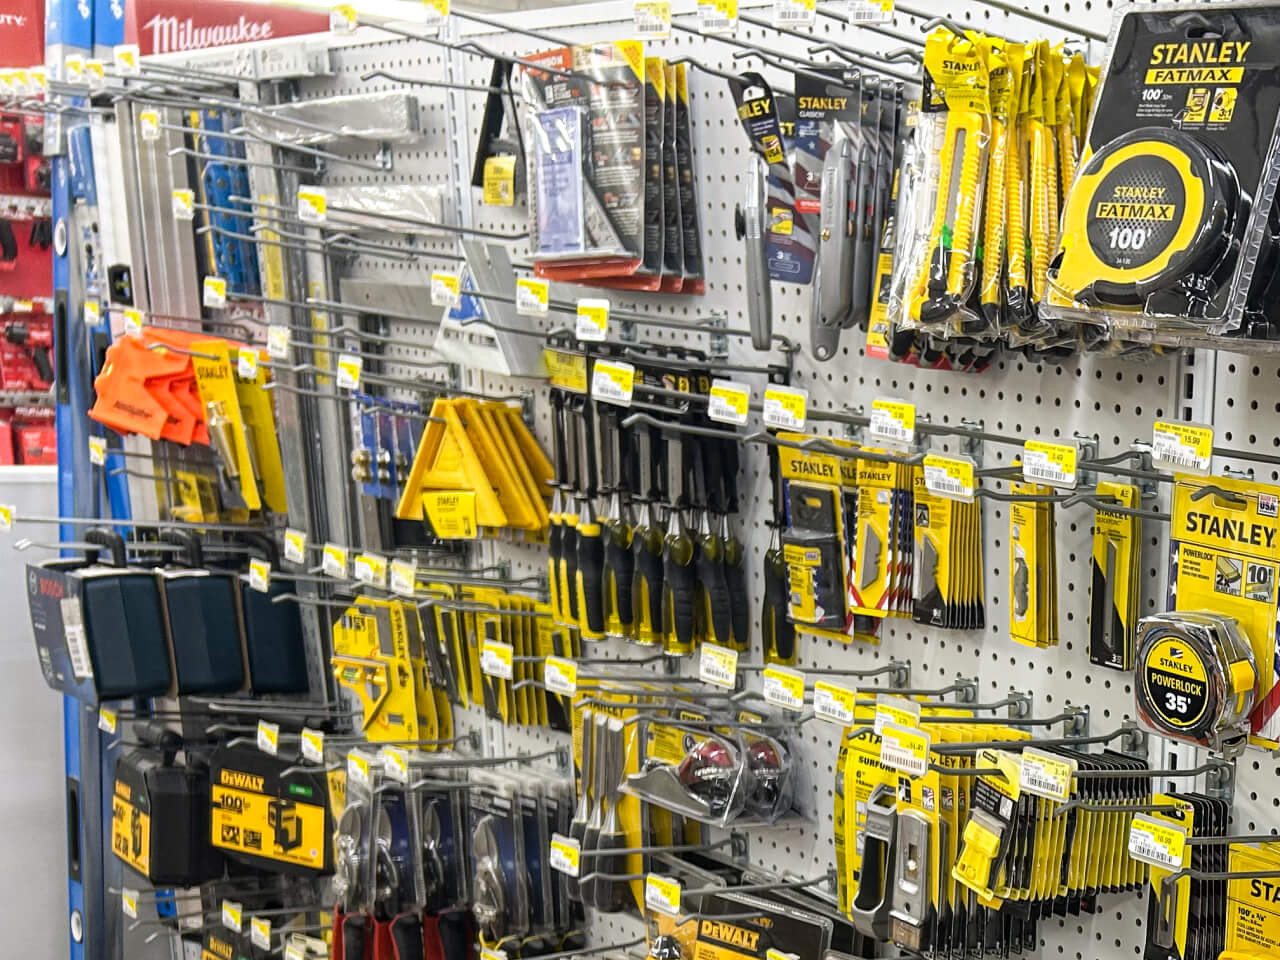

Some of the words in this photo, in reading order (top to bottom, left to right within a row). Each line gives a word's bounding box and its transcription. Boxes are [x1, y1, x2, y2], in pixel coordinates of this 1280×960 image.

[144, 14, 275, 54] Milwaukee
[1150, 41, 1250, 64] STANLEY
[1154, 69, 1232, 82] FATMAX
[1141, 89, 1163, 101] 100'
[798, 96, 847, 111] STANLEY
[1218, 108, 1231, 117] 3:1
[1113, 185, 1166, 199] STANLEY
[1098, 203, 1172, 219] FATMAX
[1108, 227, 1152, 250] 100'
[791, 461, 834, 478] STANLEY
[859, 471, 892, 481] STANLEY
[1259, 500, 1276, 512] USA
[1186, 512, 1277, 548] STANLEY
[1183, 547, 1214, 561] POWERLOCK
[1248, 565, 1272, 584] 10'
[1160, 657, 1192, 674] STANLEY
[1151, 672, 1201, 696] POWERLOCK
[1165, 693, 1192, 714] 35'
